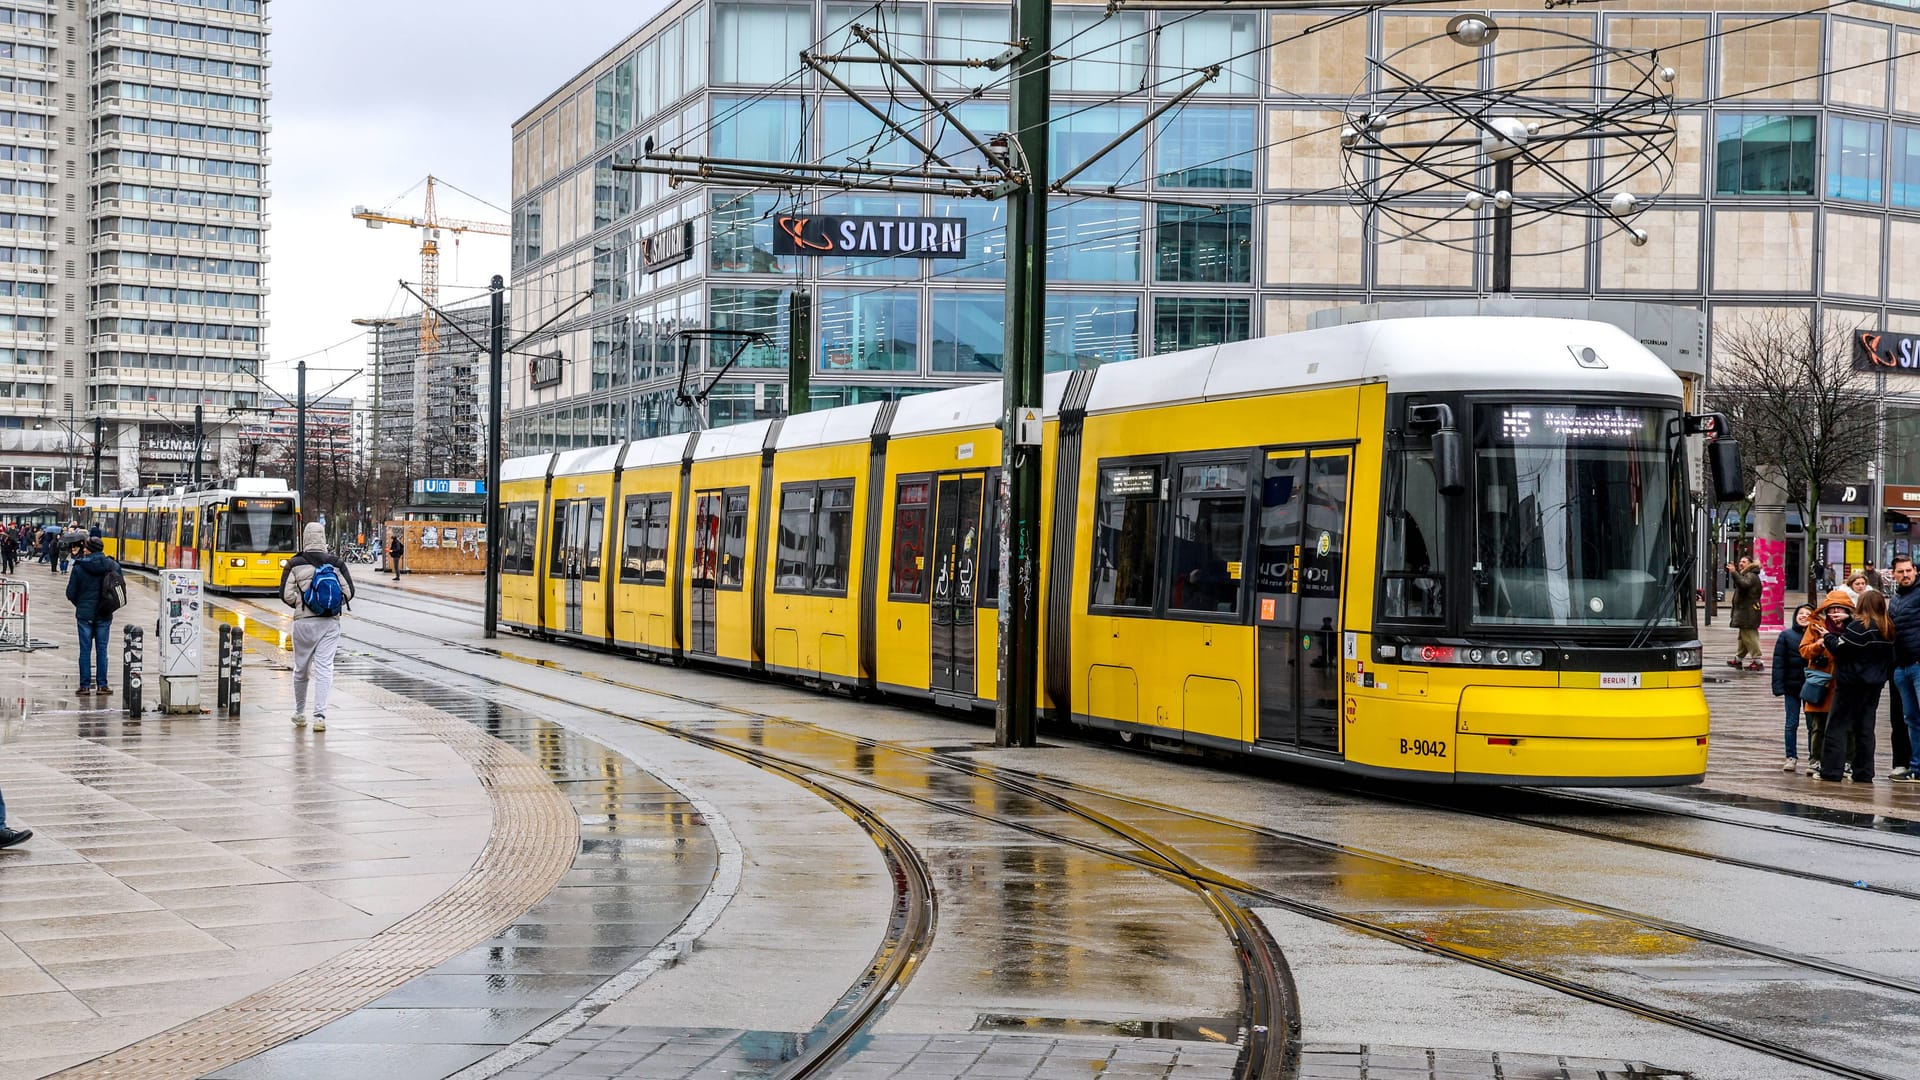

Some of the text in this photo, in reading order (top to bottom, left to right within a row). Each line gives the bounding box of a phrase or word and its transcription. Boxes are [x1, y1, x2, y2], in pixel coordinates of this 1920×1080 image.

[839, 220, 961, 252] SATURN
[1503, 411, 1532, 438] M5
[1842, 487, 1857, 502] JD
[1345, 672, 1356, 683] BVG
[1400, 738, 1446, 757] B-9042
